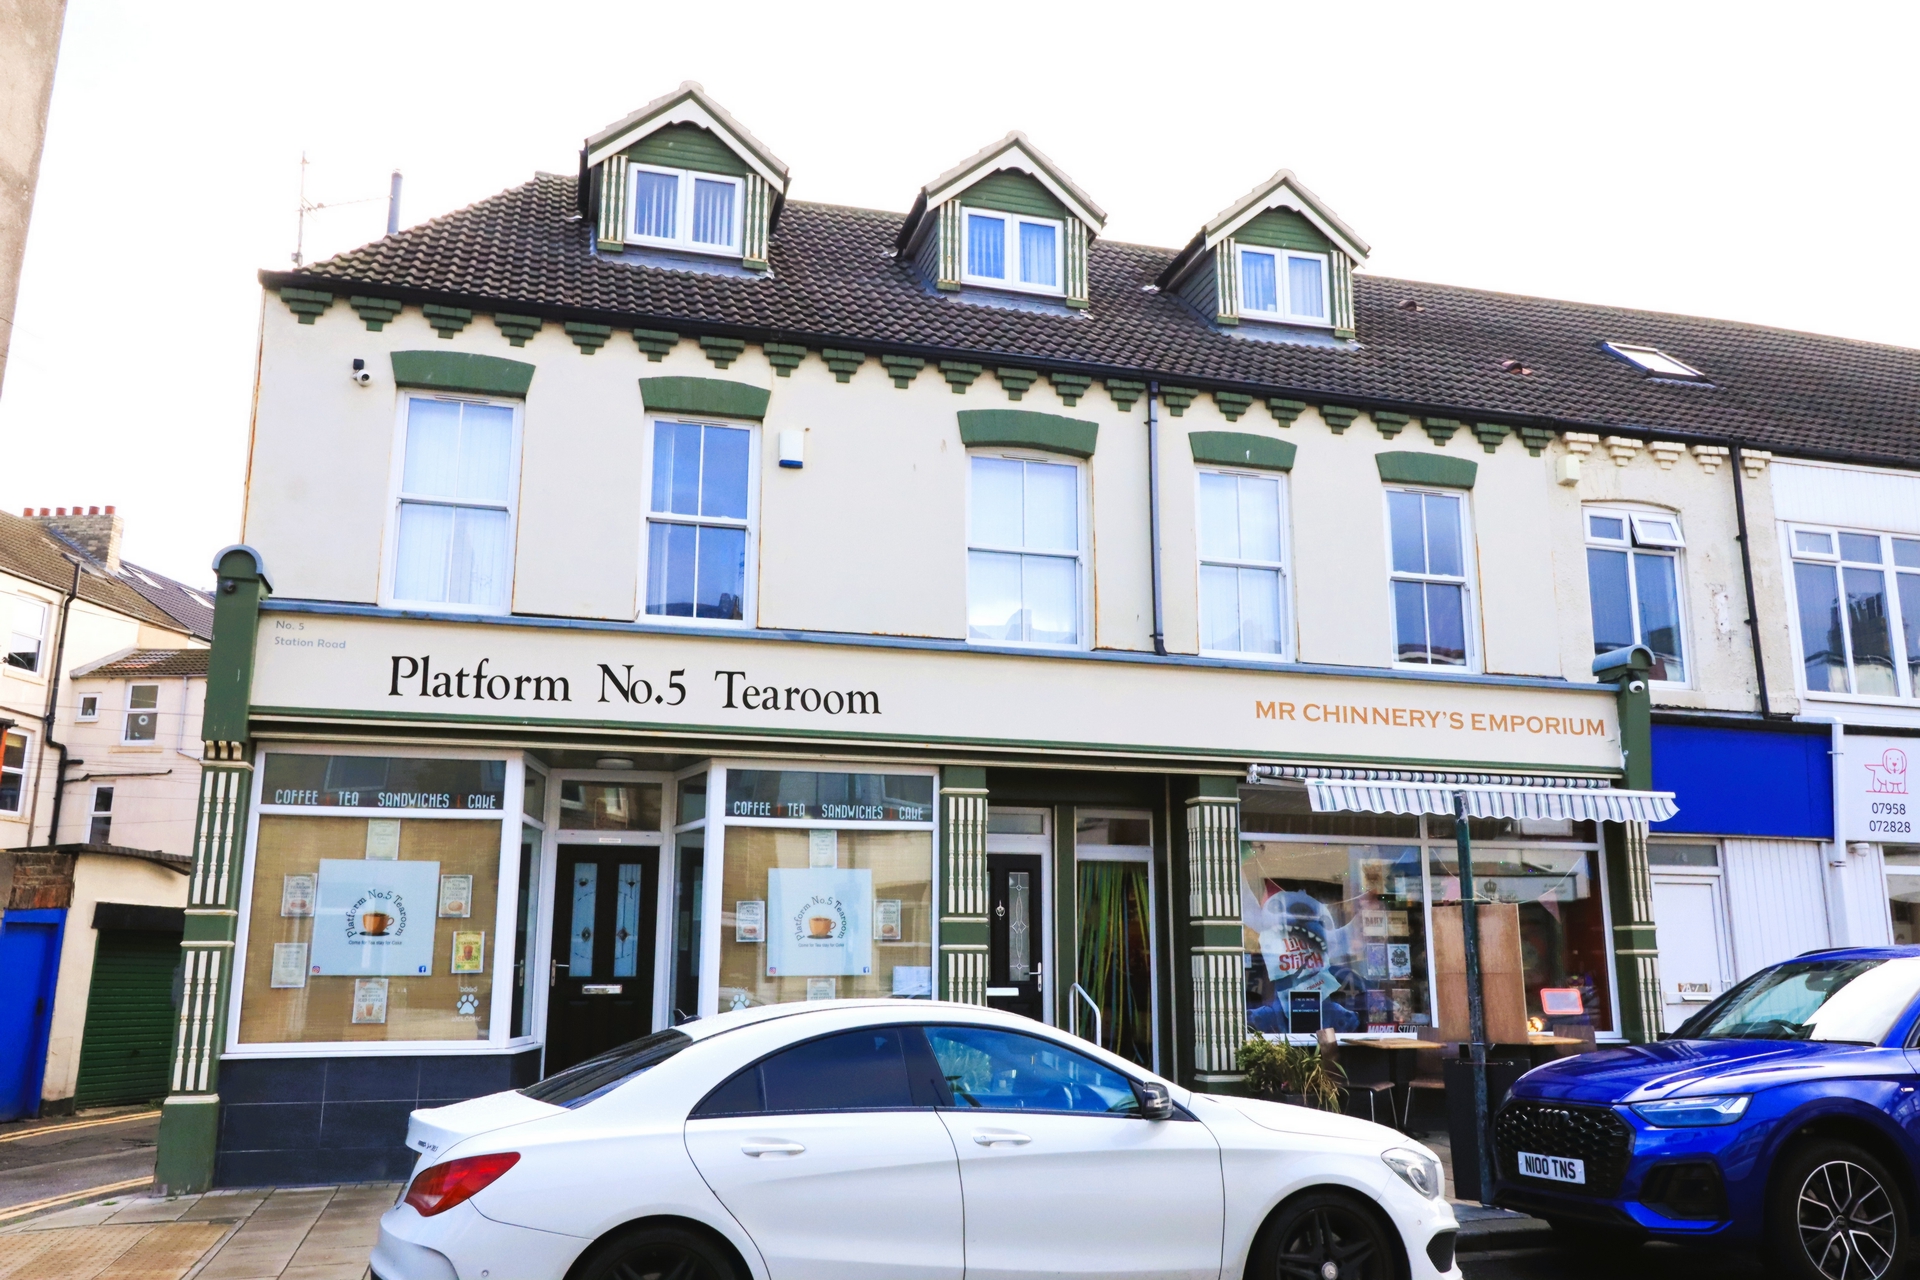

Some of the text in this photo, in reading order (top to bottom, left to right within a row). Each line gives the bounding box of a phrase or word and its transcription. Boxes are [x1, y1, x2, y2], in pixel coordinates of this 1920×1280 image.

[276, 619, 305, 631] No. 5
[274, 636, 346, 650] Station Road
[388, 655, 882, 715] Platform No.5 Tearoom
[1255, 700, 1605, 737] MR CHINNERY'S EMPORIUM
[275, 789, 496, 809] COFFEE TEA SANDWICHES CAKE
[1871, 802, 1906, 815] 07958
[734, 800, 924, 820] COFFEE TEA SANDWICHES CAKE
[1869, 820, 1911, 833] 072828
[345, 889, 407, 938] Platform No.5 Tearoom
[793, 903, 811, 941] Platform
[811, 895, 833, 906] No.5
[834, 899, 847, 939] Tearoom
[1367, 1025, 1395, 1033] MARVEL
[1552, 1159, 1576, 1180] TNS
